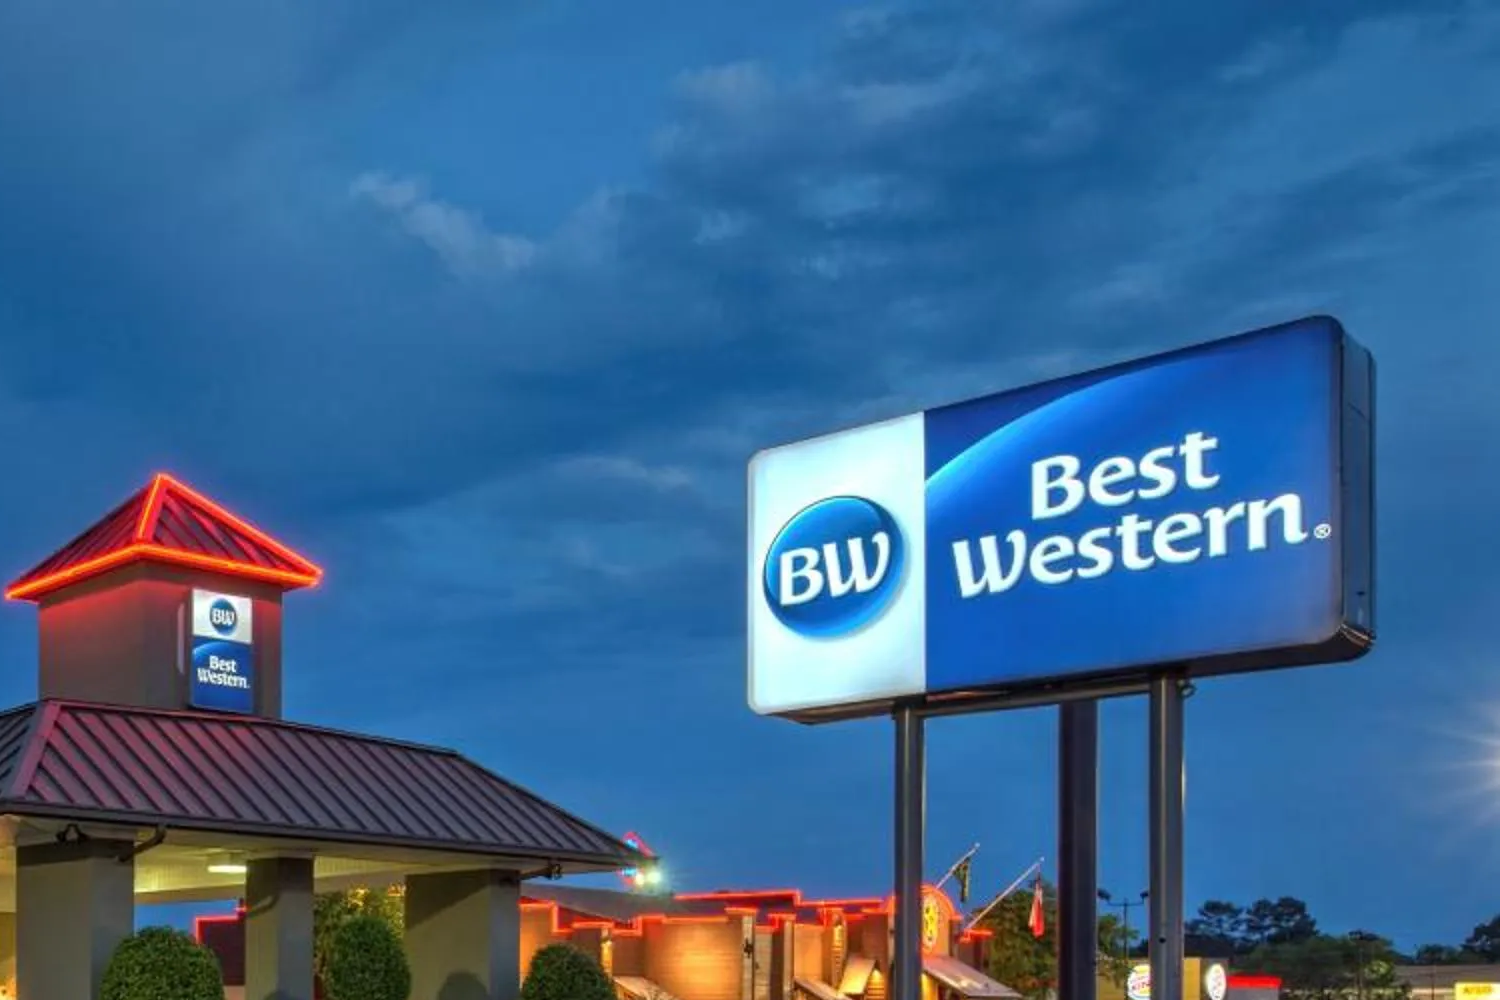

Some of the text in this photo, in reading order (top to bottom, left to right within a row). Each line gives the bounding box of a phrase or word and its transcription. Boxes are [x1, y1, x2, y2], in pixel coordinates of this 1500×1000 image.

[1031, 431, 1221, 520] Best
[780, 531, 891, 606] BW
[211, 609, 235, 626] BW
[210, 655, 237, 672] Best
